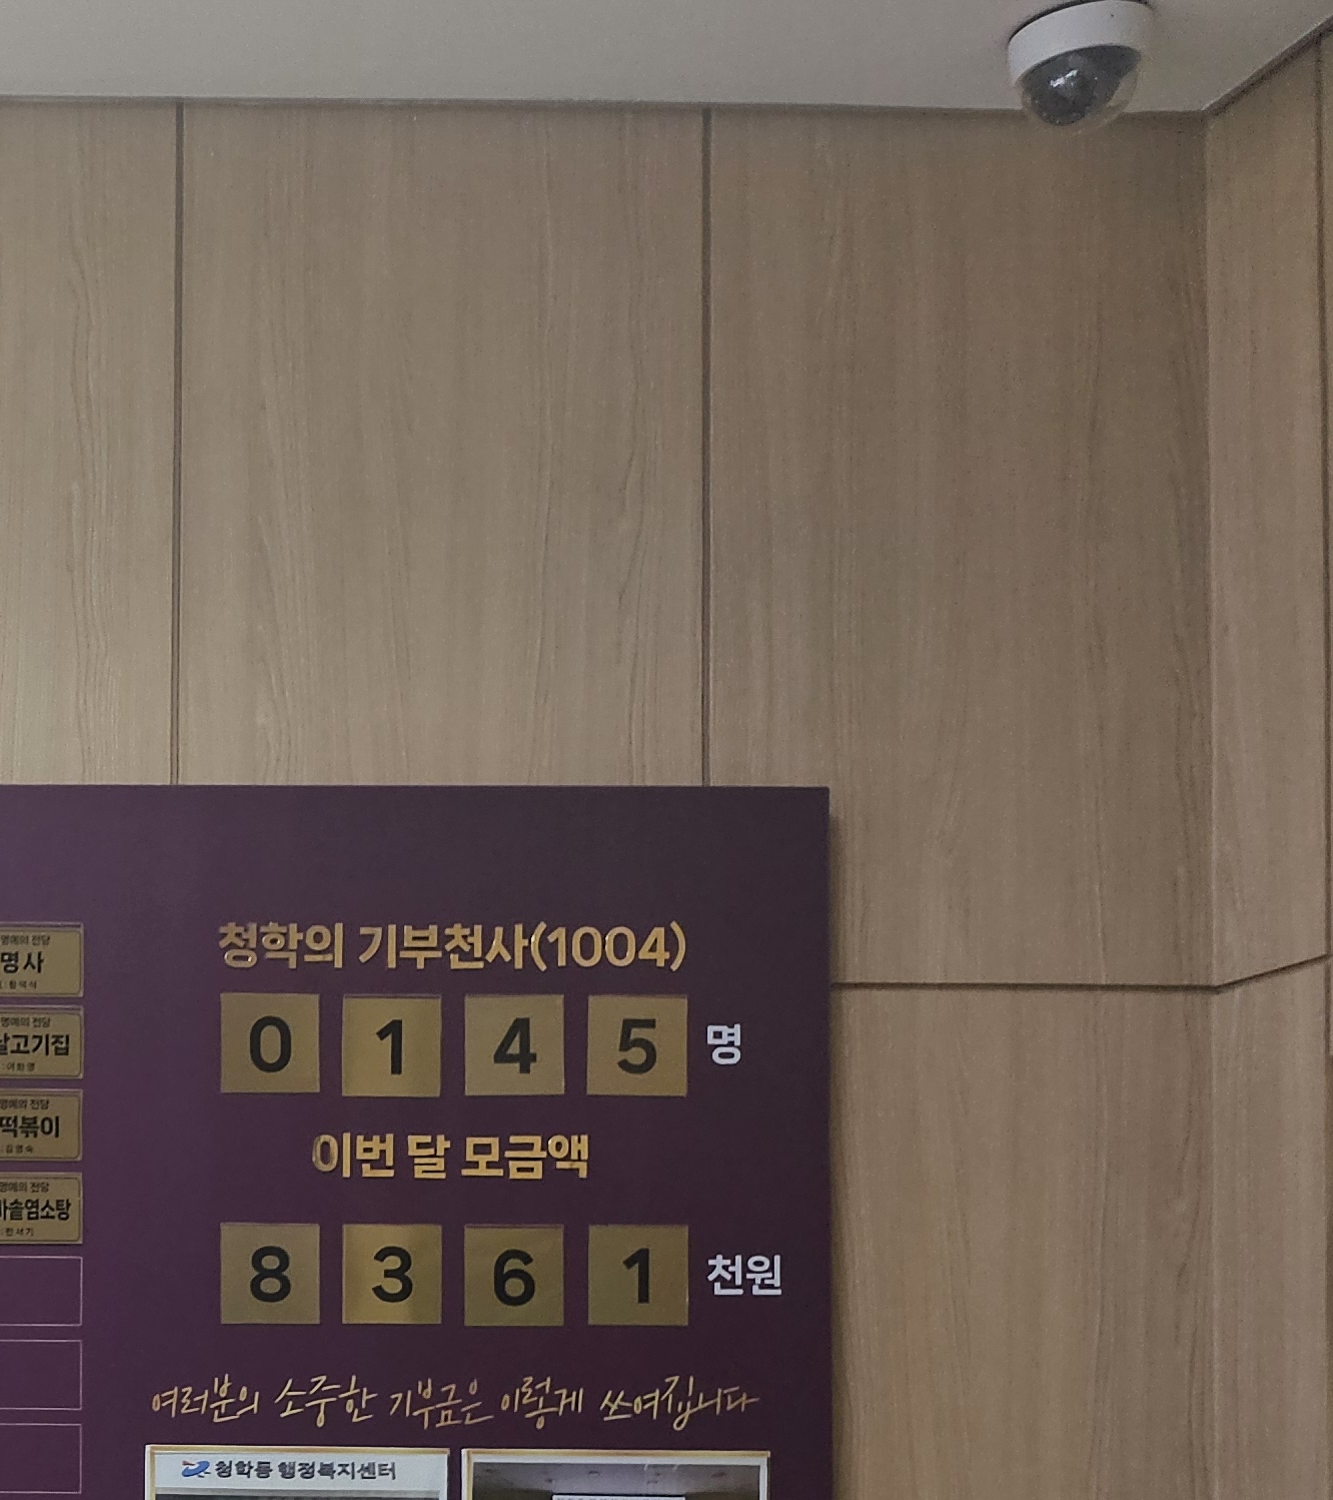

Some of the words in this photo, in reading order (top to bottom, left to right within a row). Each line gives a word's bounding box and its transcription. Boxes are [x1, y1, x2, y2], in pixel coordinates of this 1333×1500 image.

[218, 921, 344, 970] 청학의
[358, 921, 687, 972] 기부천사(1004)
[707, 1023, 741, 1066] 명
[312, 1132, 395, 1179] 이번
[407, 1135, 450, 1180] 달
[460, 1134, 591, 1179] 모금액
[707, 1254, 783, 1297] 천원
[151, 1373, 261, 1422] 여러분의
[275, 1374, 378, 1428] 소중한
[389, 1377, 494, 1431] 기부금은
[501, 1376, 584, 1431] 이렇게
[600, 1374, 759, 1432] 쓰여집니다
